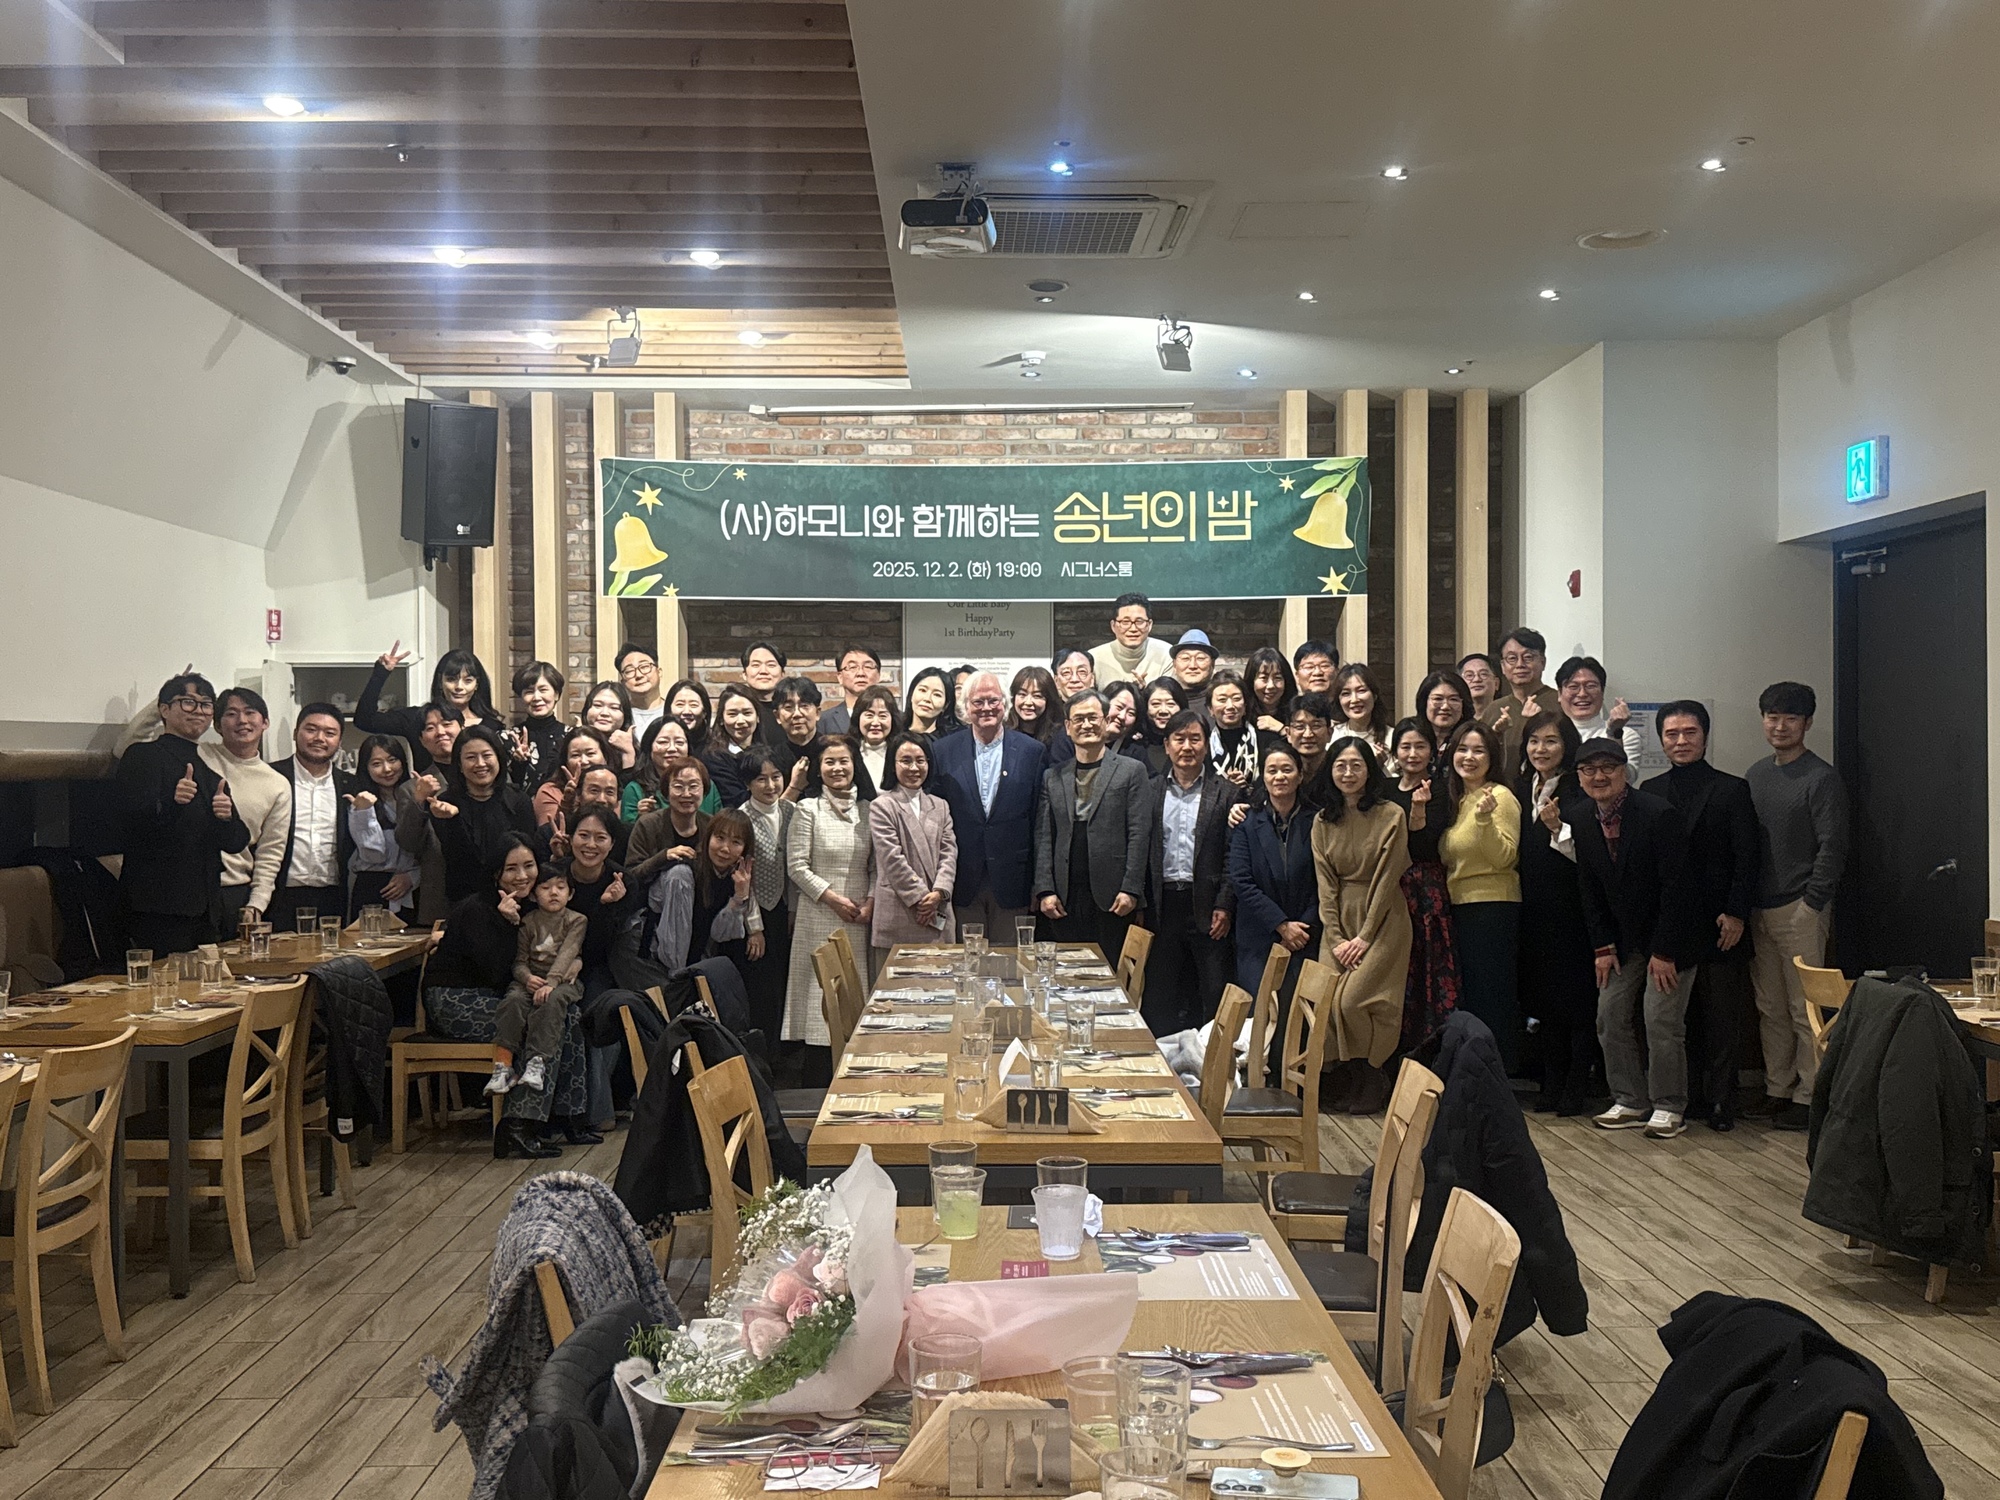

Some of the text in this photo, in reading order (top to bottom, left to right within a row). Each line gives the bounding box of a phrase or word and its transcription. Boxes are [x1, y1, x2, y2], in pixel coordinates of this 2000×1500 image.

[720, 490, 1259, 544] (사)하모니와 함께하는 송년의 밤
[872, 559, 1133, 580] 2025. 12. 2. (화) 19:00 시그너스룸
[965, 613, 994, 625] Happy
[944, 627, 955, 637] 1st
